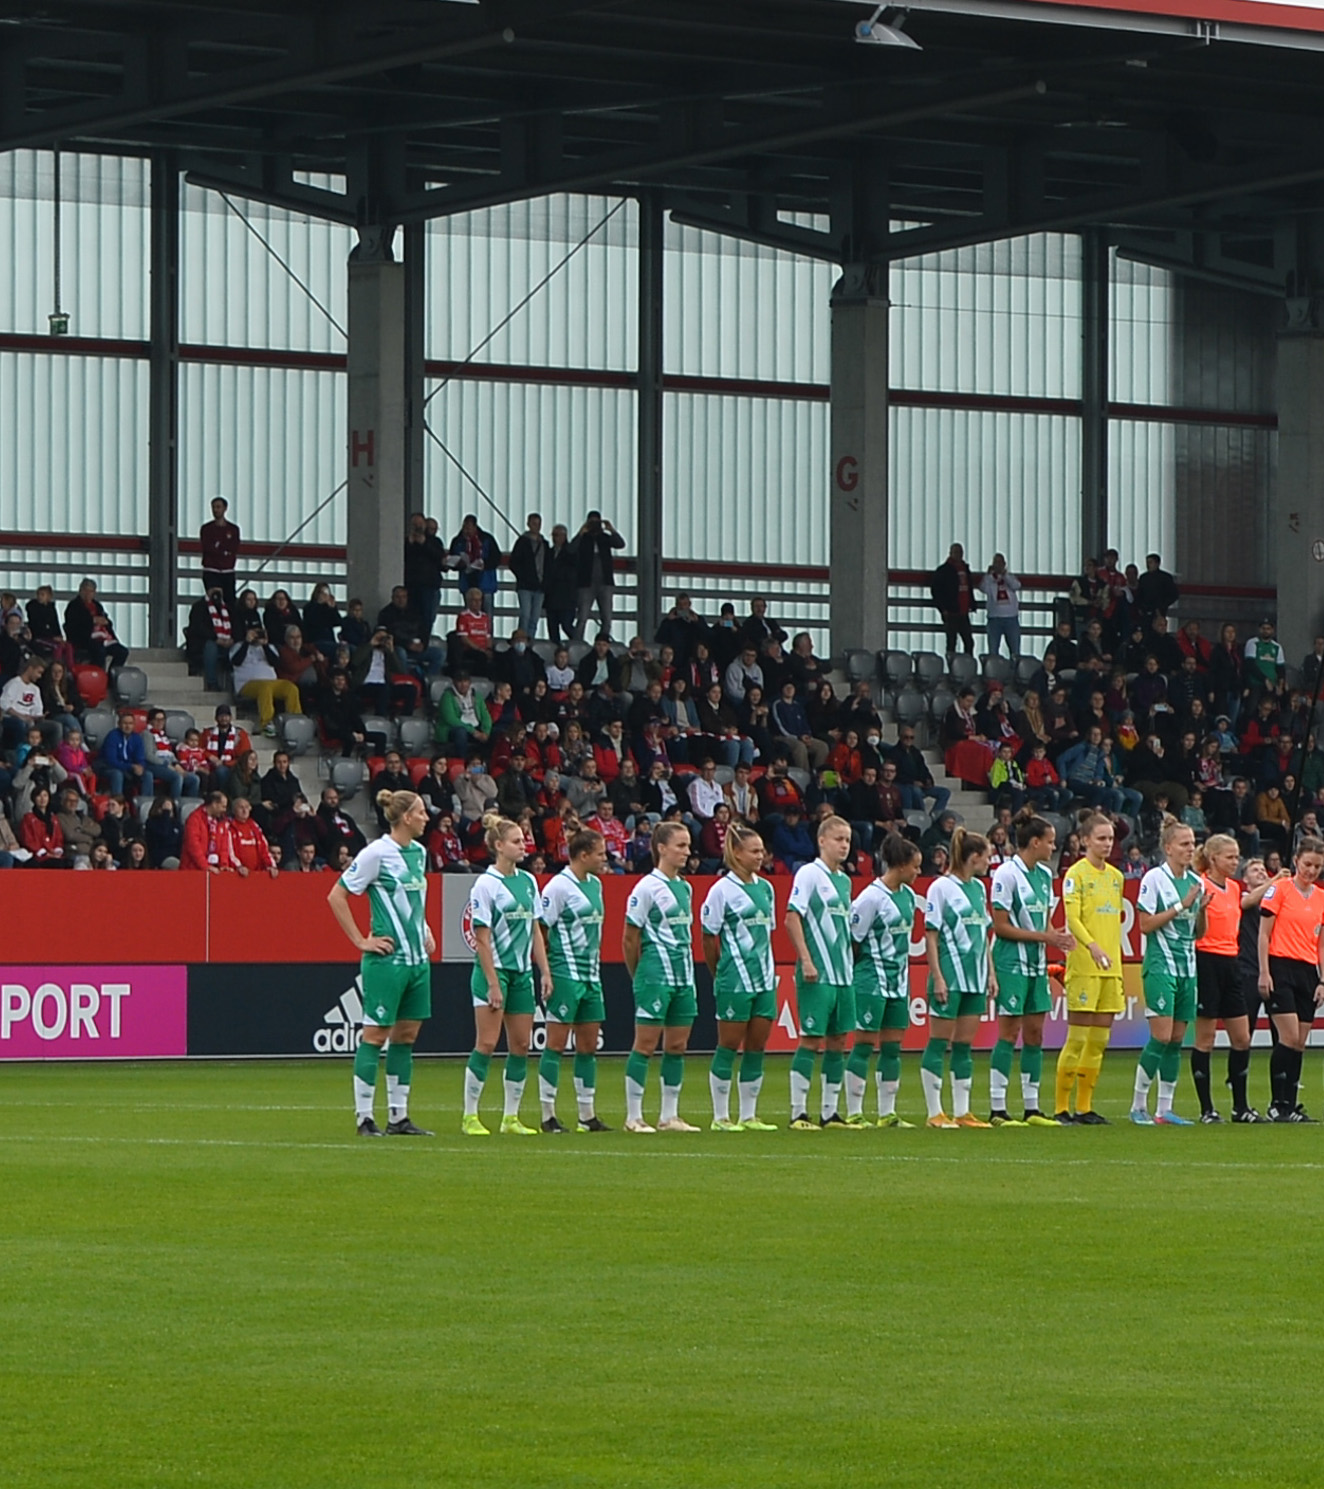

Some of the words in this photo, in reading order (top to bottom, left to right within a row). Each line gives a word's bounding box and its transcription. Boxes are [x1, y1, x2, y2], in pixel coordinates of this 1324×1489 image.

[352, 430, 374, 467] H
[836, 456, 858, 492] G
[313, 1021, 390, 1053] adi
